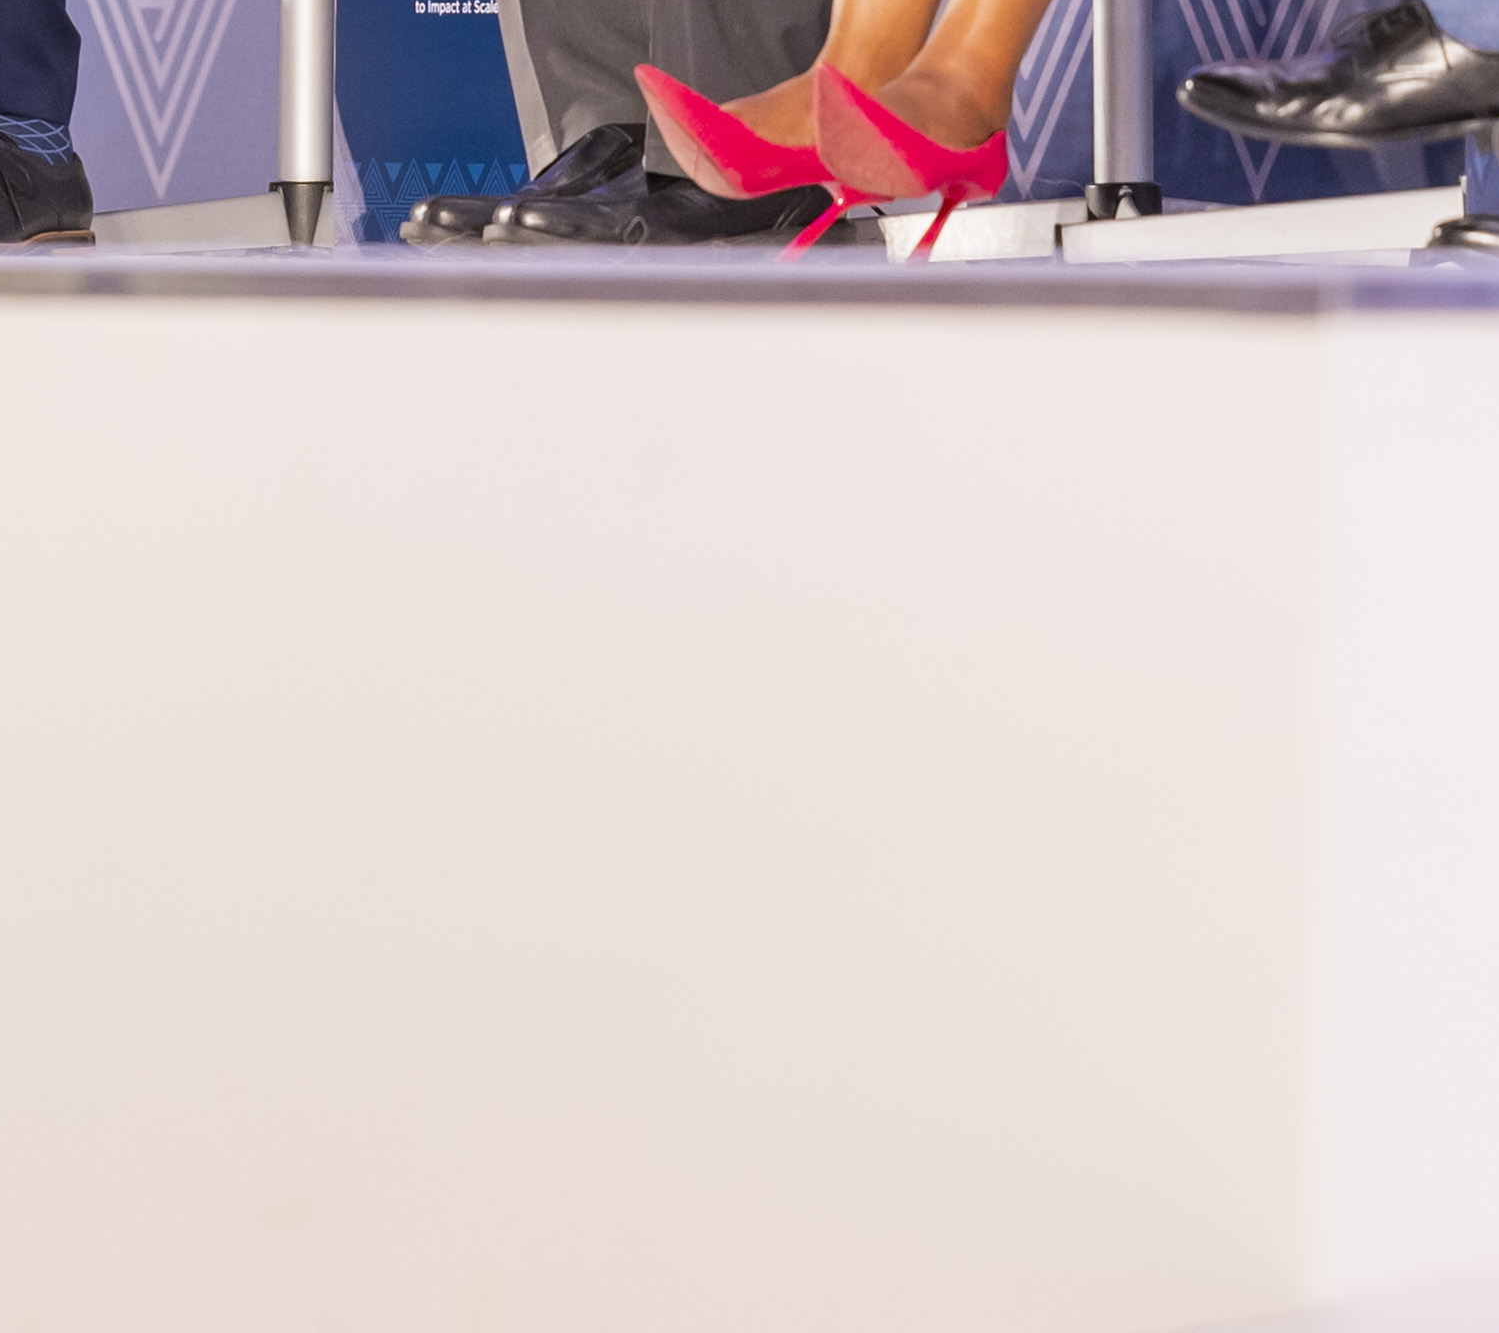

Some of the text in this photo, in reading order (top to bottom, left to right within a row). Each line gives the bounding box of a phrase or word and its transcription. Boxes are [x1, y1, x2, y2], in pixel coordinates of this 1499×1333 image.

[415, 0, 499, 16] to Impact at Scale
